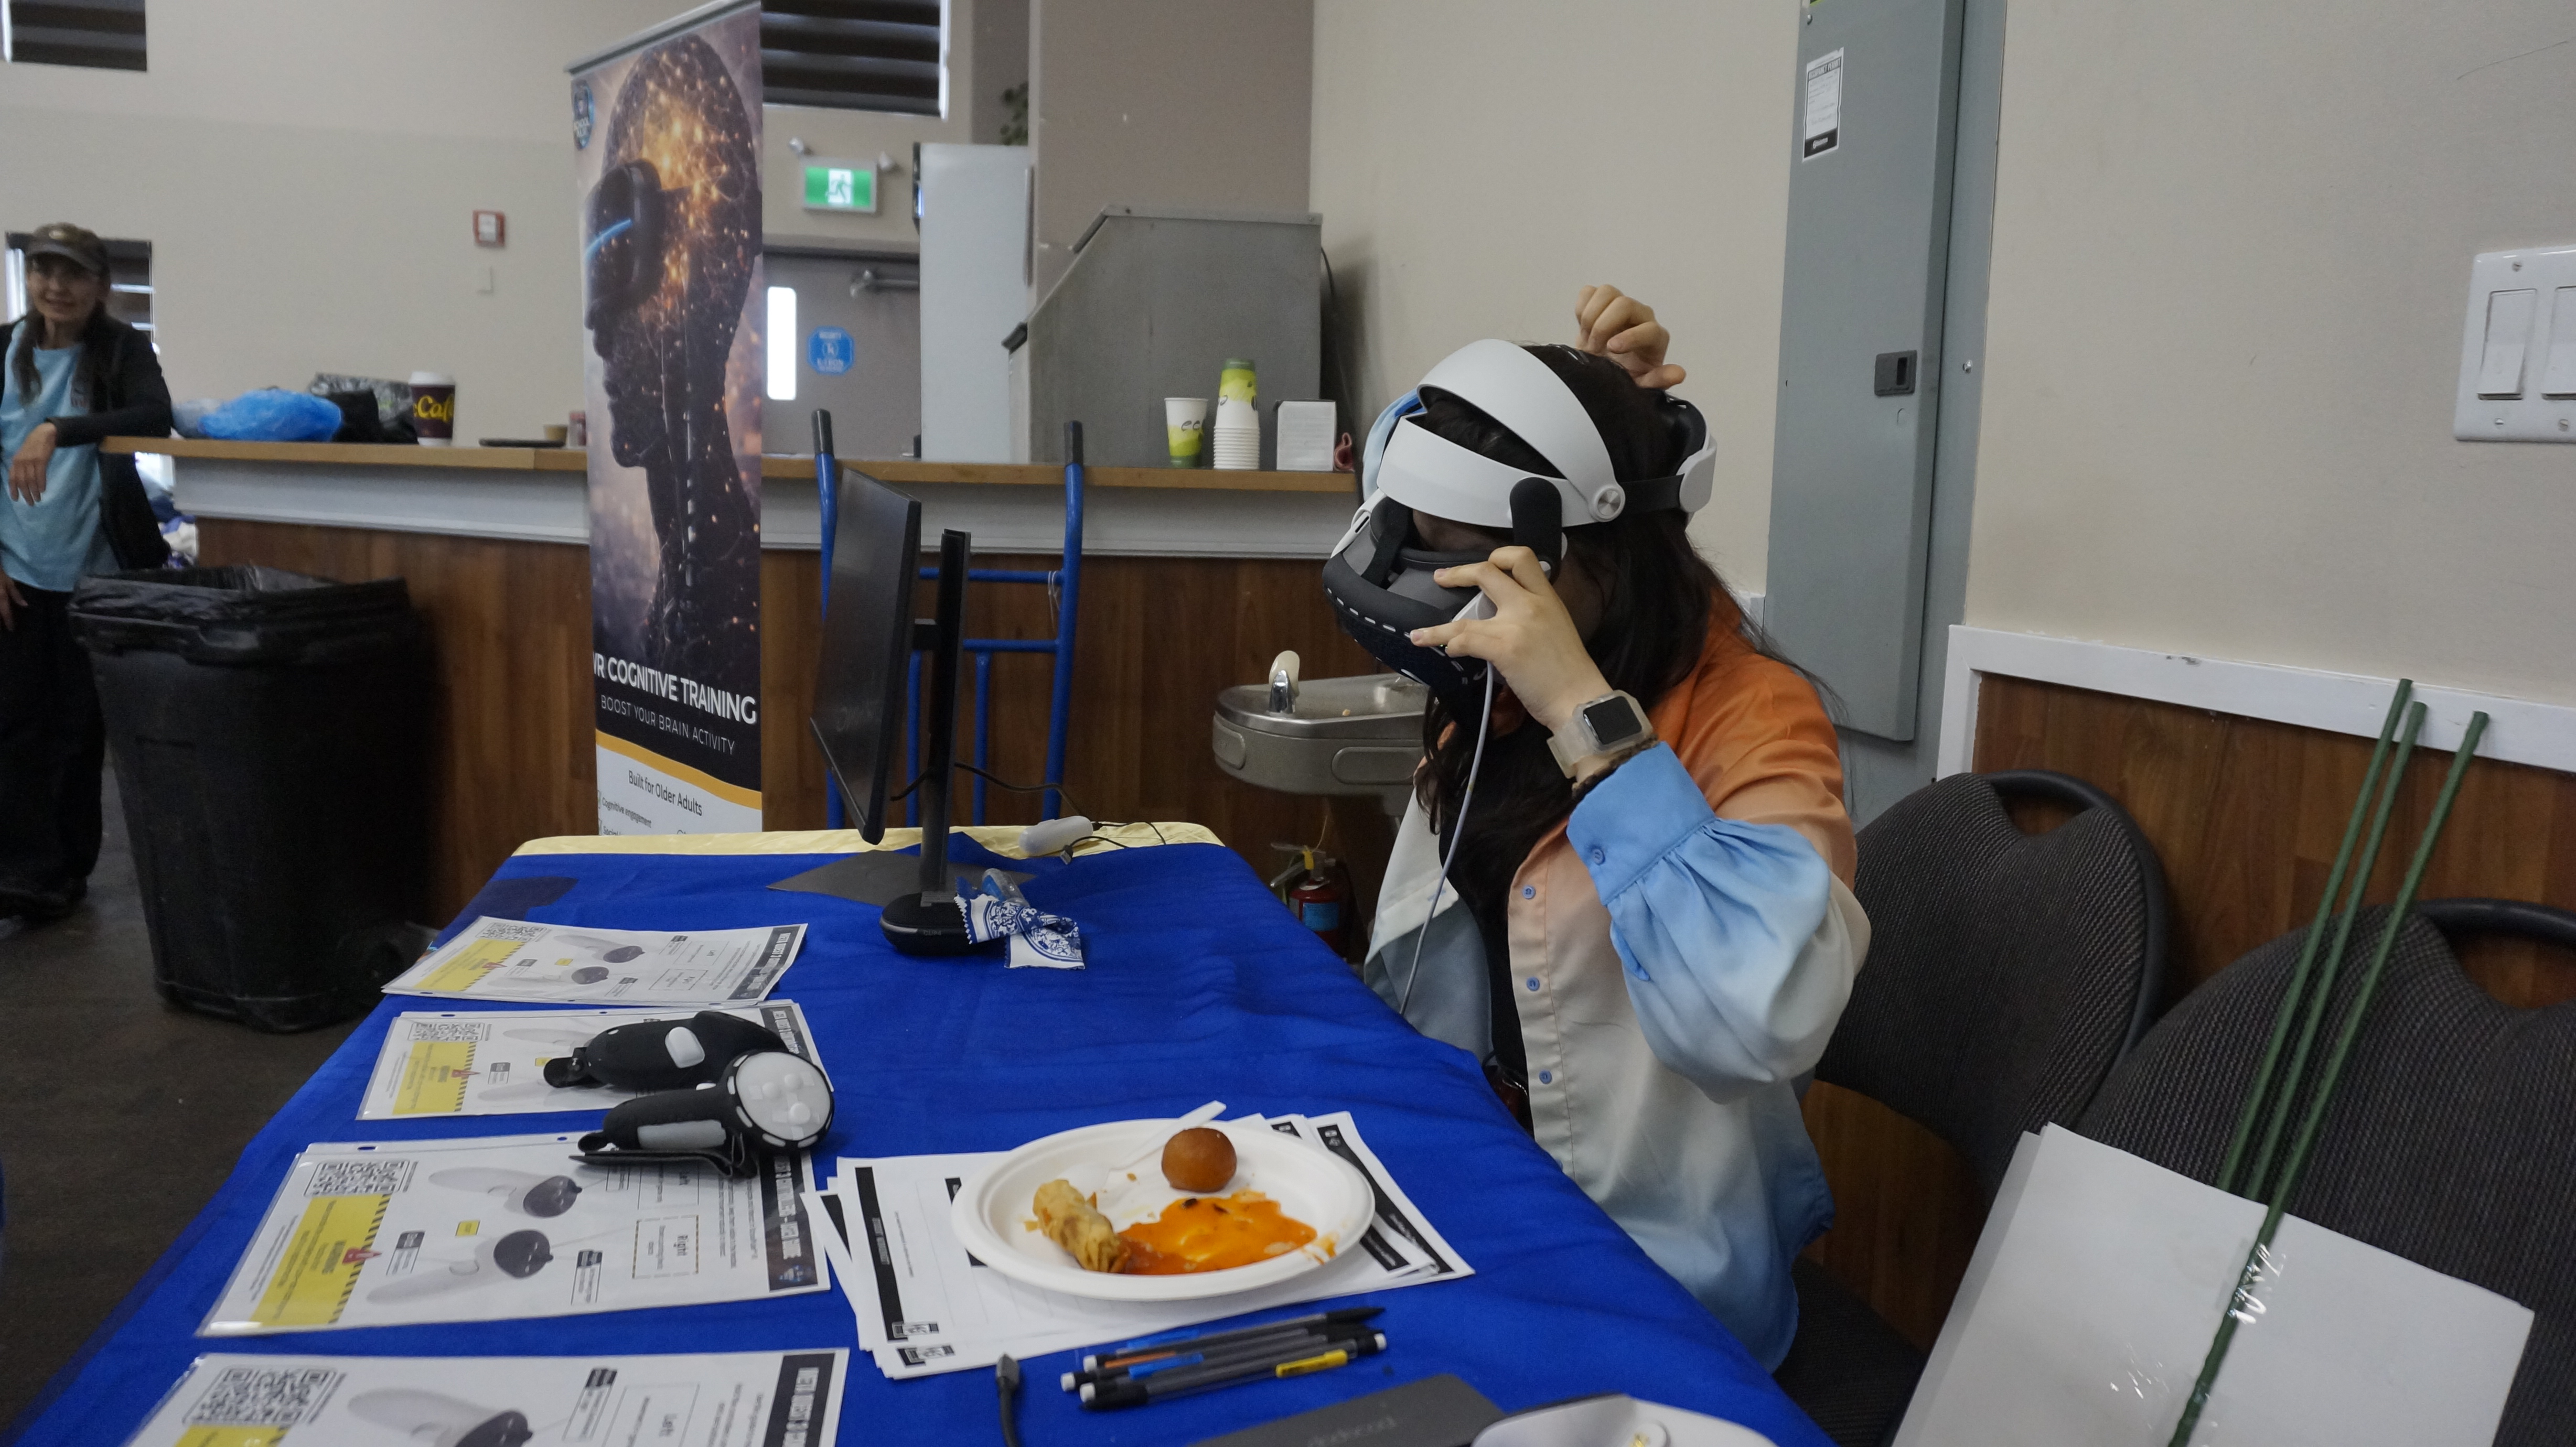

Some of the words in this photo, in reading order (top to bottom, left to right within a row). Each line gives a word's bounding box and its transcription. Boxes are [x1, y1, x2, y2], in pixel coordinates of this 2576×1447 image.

[607, 657, 678, 701] COGNITIVE
[680, 677, 757, 725] TRAINING
[601, 695, 631, 717] BOOST
[634, 705, 656, 727] YOUR
[659, 714, 689, 738] BRAIN
[692, 727, 735, 755] ACTIVITY
[602, 797, 625, 814] Cognitive
[625, 808, 652, 828] engagement
[629, 770, 644, 790] Built
[645, 777, 654, 795] for
[656, 783, 676, 804] Older
[677, 793, 703, 816] Adults
